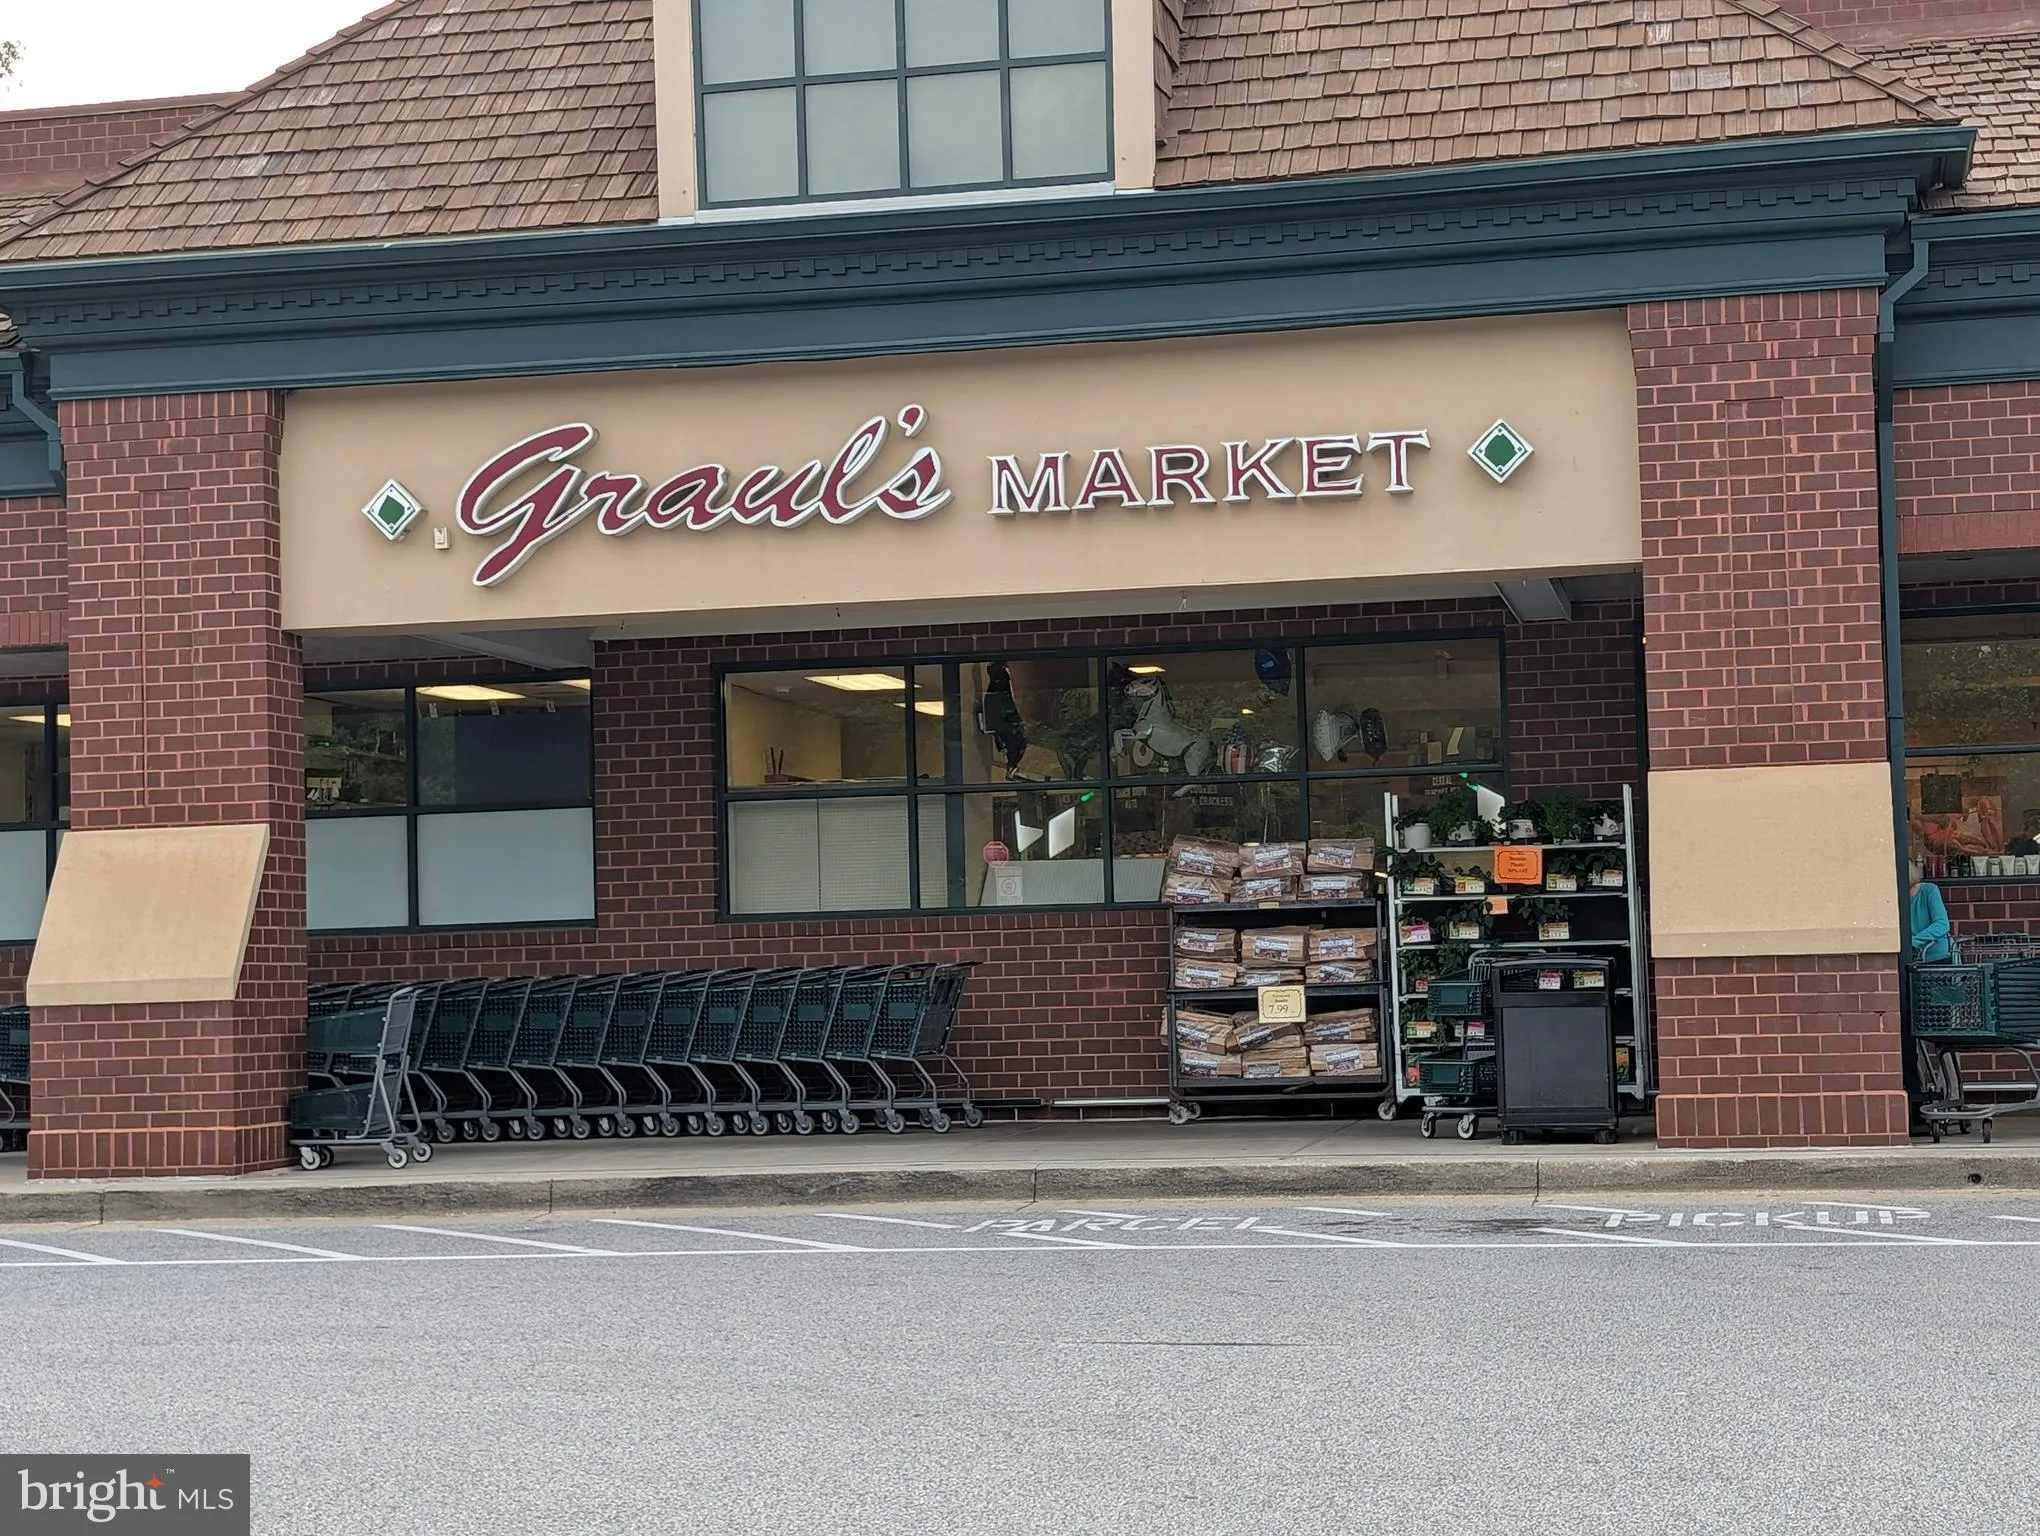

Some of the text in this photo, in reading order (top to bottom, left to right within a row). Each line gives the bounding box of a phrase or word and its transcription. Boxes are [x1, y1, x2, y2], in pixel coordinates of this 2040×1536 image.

[456, 404, 1432, 588] Graul's MARKET
[1268, 1004, 1289, 1014] 7.99
[961, 1217, 1283, 1233] PARCEL
[1604, 1210, 1932, 1228] PICKUP
